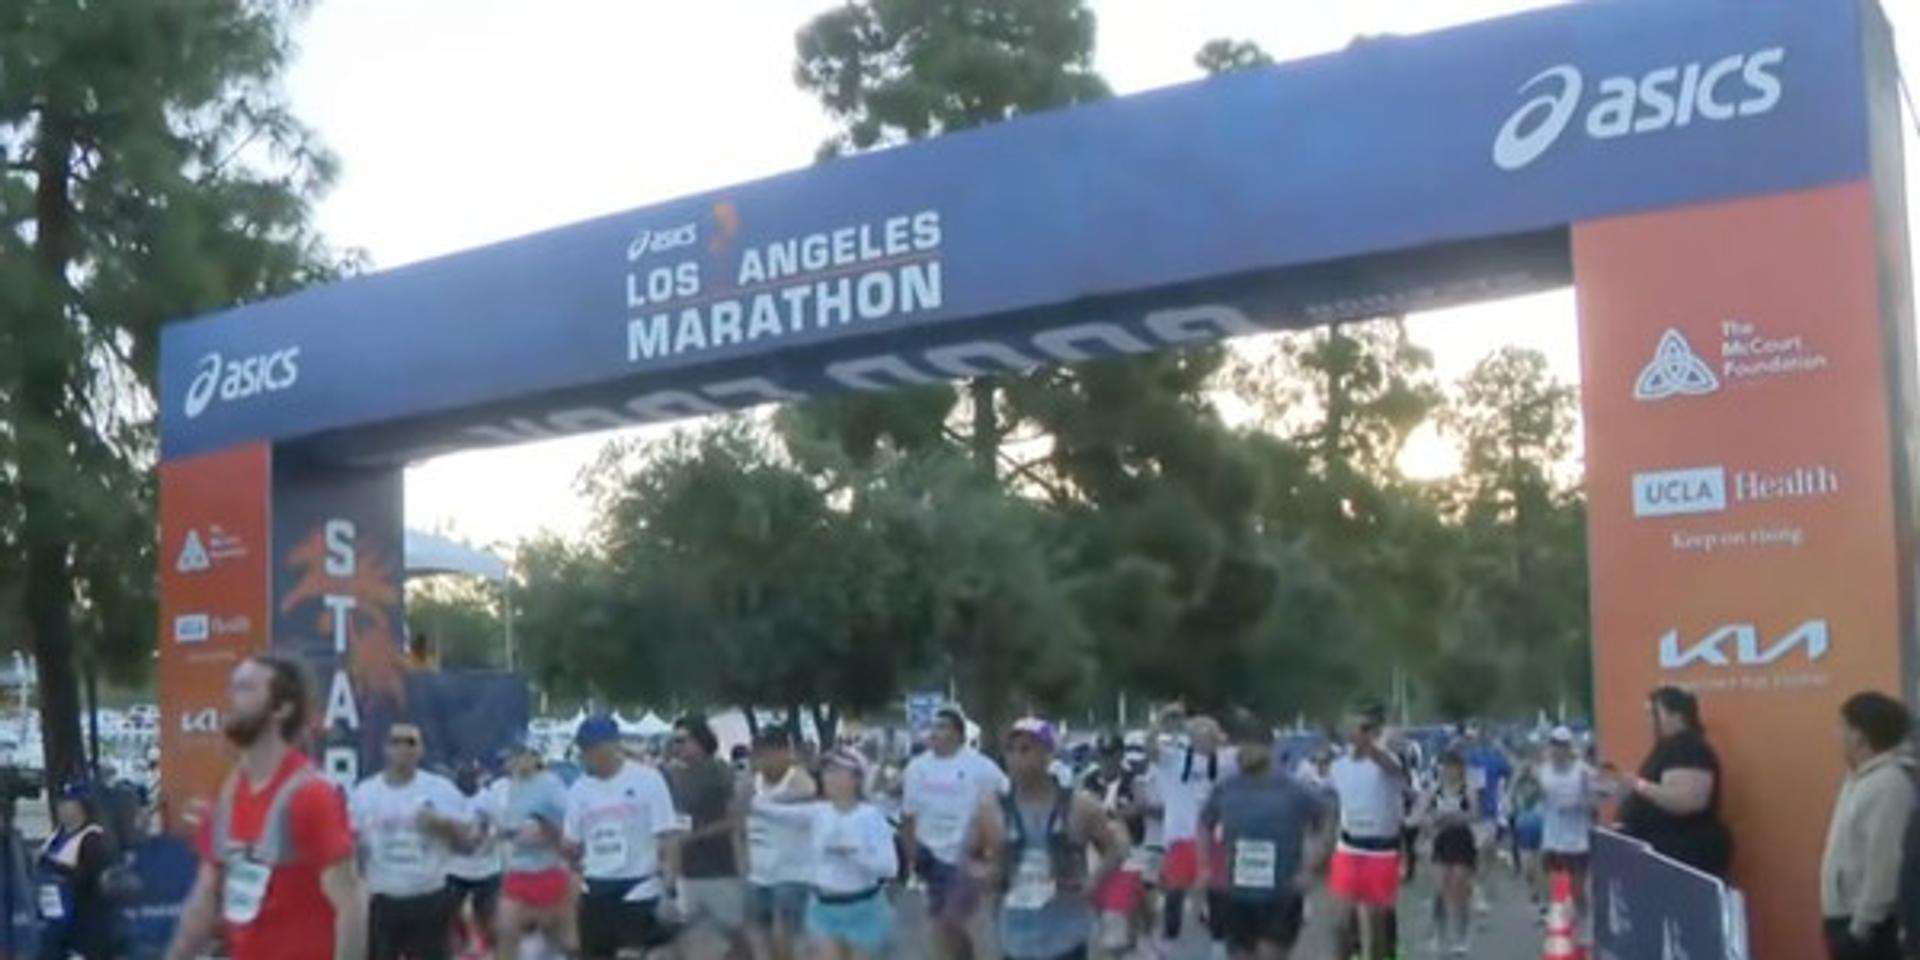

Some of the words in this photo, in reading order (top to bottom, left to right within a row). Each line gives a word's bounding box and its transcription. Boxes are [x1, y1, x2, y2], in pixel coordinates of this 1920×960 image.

[626, 262, 700, 308] LOS
[738, 210, 942, 286] ANGELES
[627, 261, 943, 362] MARATHON
[1722, 320, 1753, 337] The
[1644, 480, 1713, 504] UCLA
[1735, 466, 1838, 500] Health
[1672, 530, 1717, 553] Keep
[1659, 618, 1829, 669] KIA
